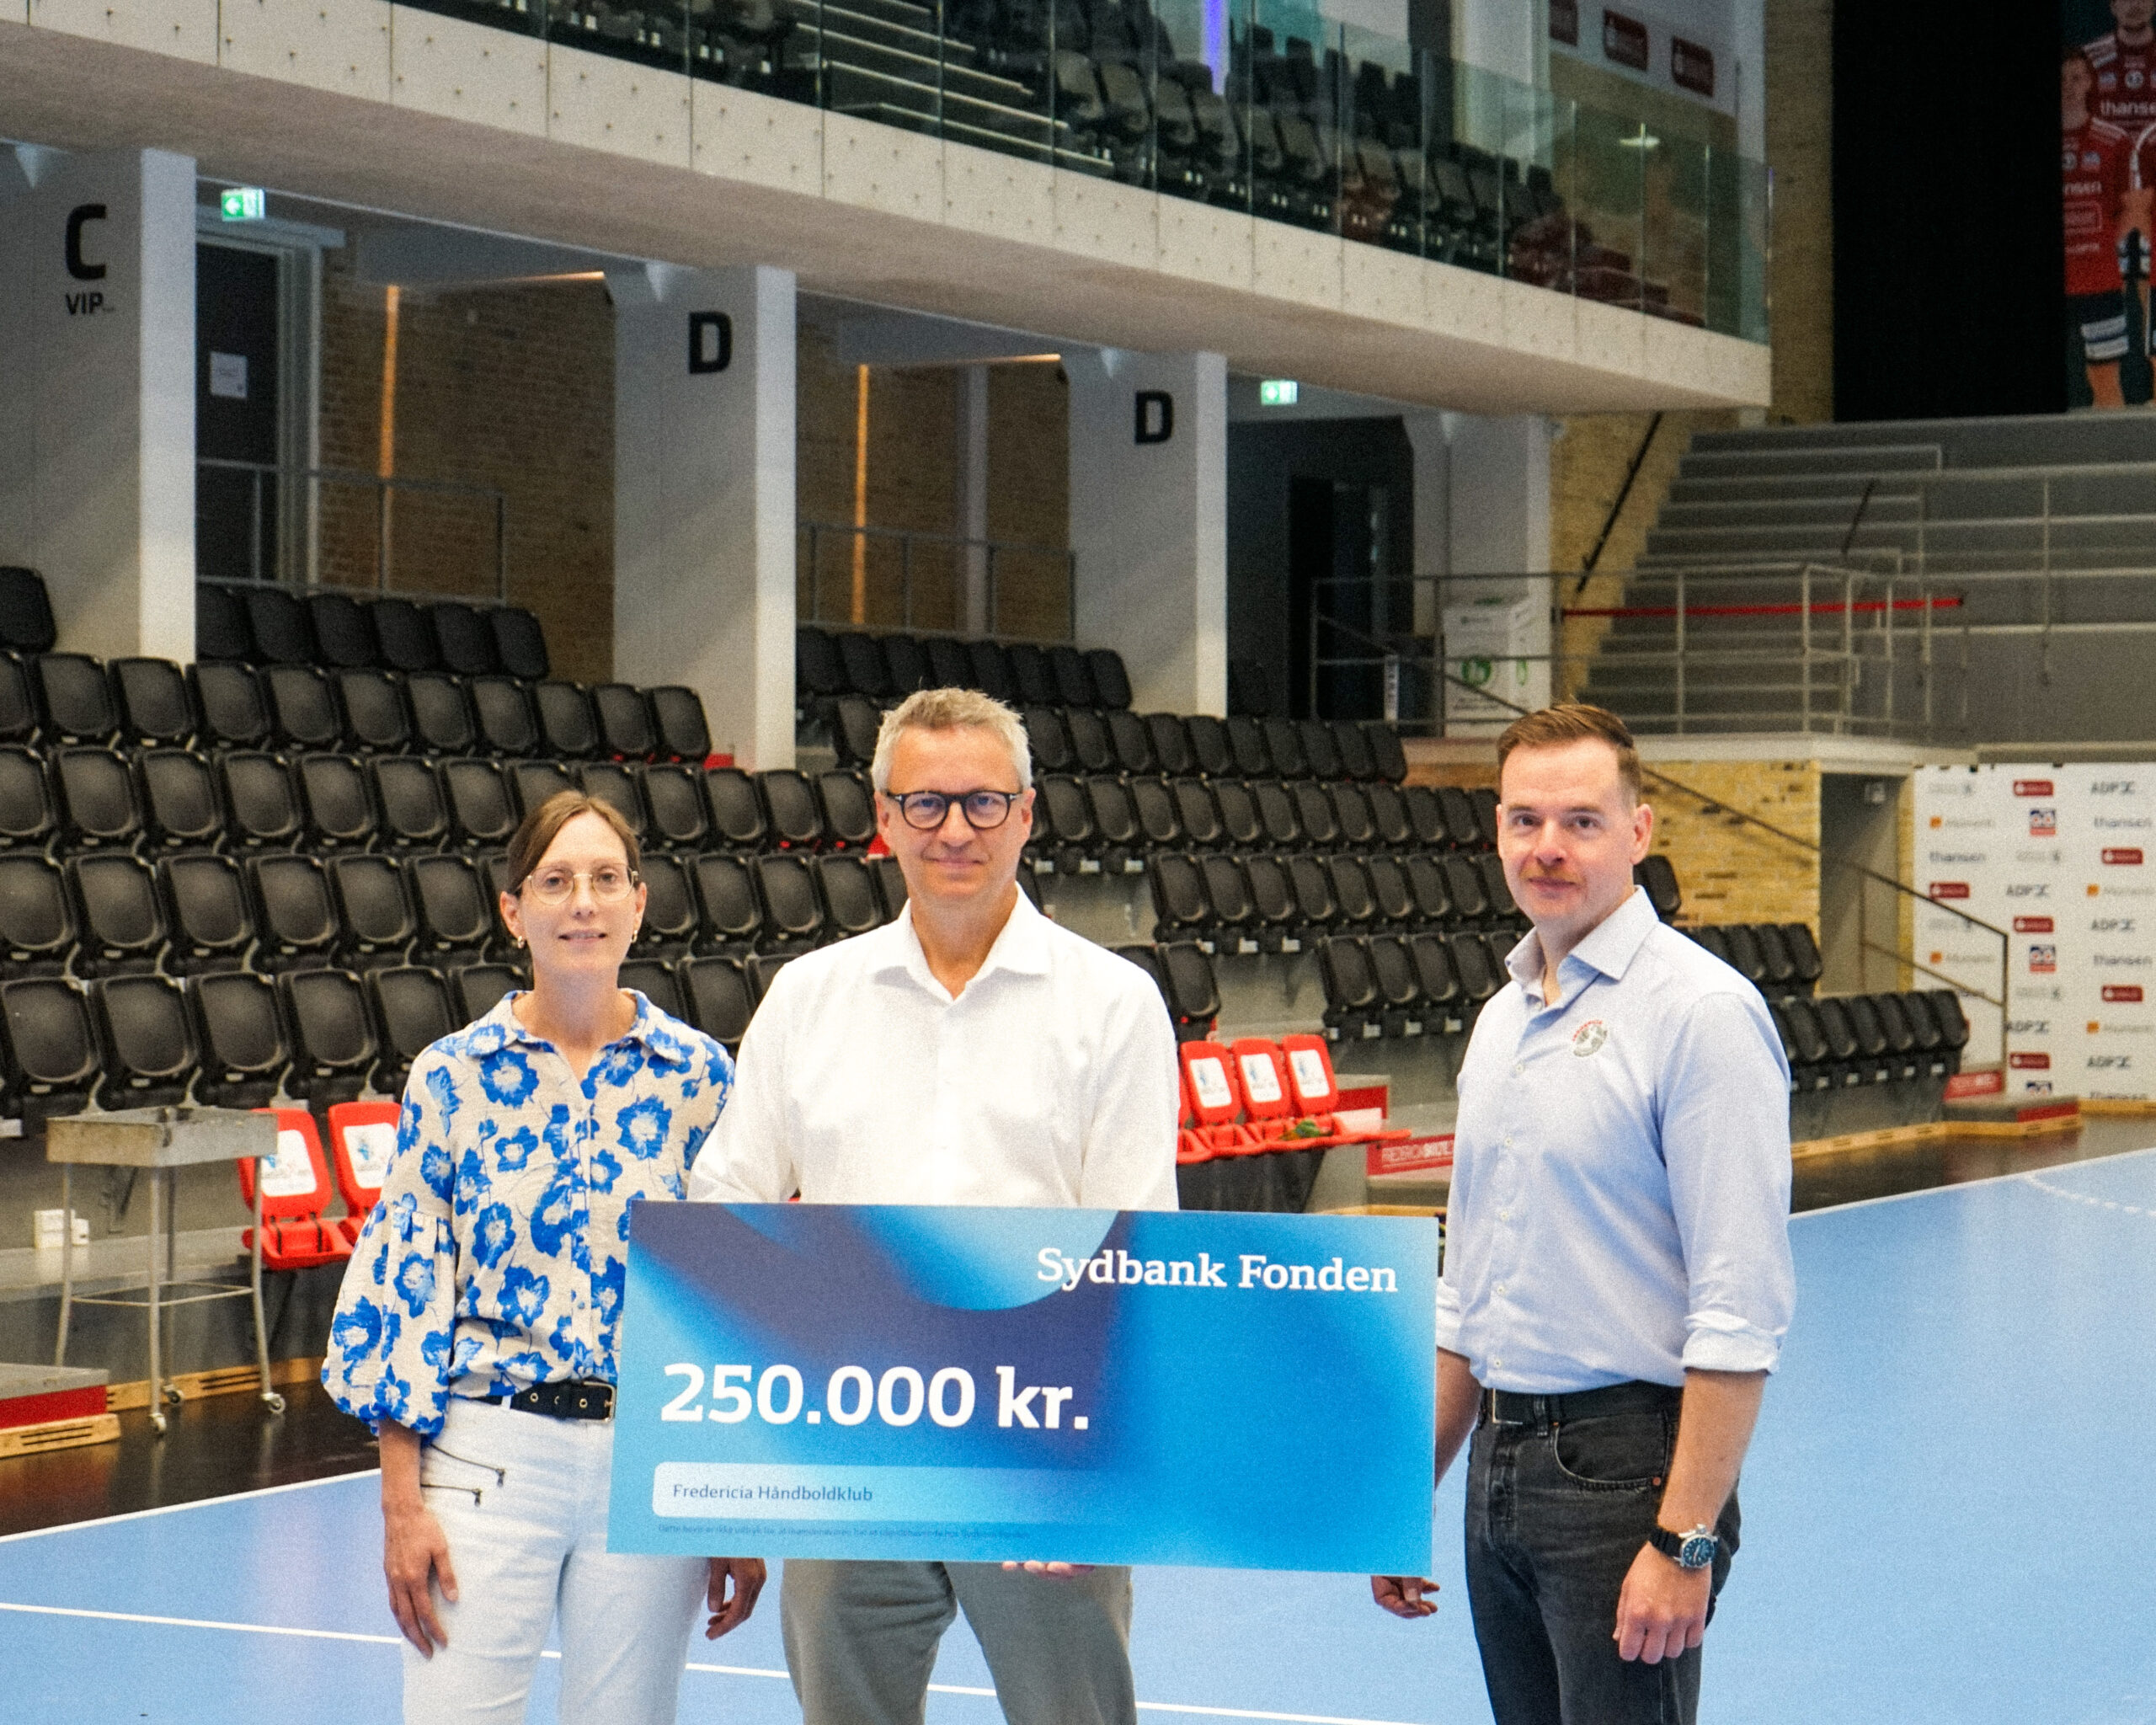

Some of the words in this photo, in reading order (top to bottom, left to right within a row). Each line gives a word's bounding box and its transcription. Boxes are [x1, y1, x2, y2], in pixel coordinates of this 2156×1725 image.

[65, 204, 107, 280] C
[65, 291, 104, 316] VIP
[688, 311, 732, 374] D
[1134, 390, 1175, 445] D
[1037, 1247, 1227, 1291] Sydbank
[1238, 1254, 1398, 1293] Fonden
[660, 1363, 976, 1428] 250.000
[995, 1365, 1089, 1430] kr.
[673, 1483, 754, 1499] Fredericia
[758, 1485, 873, 1502] Håndboldklub
